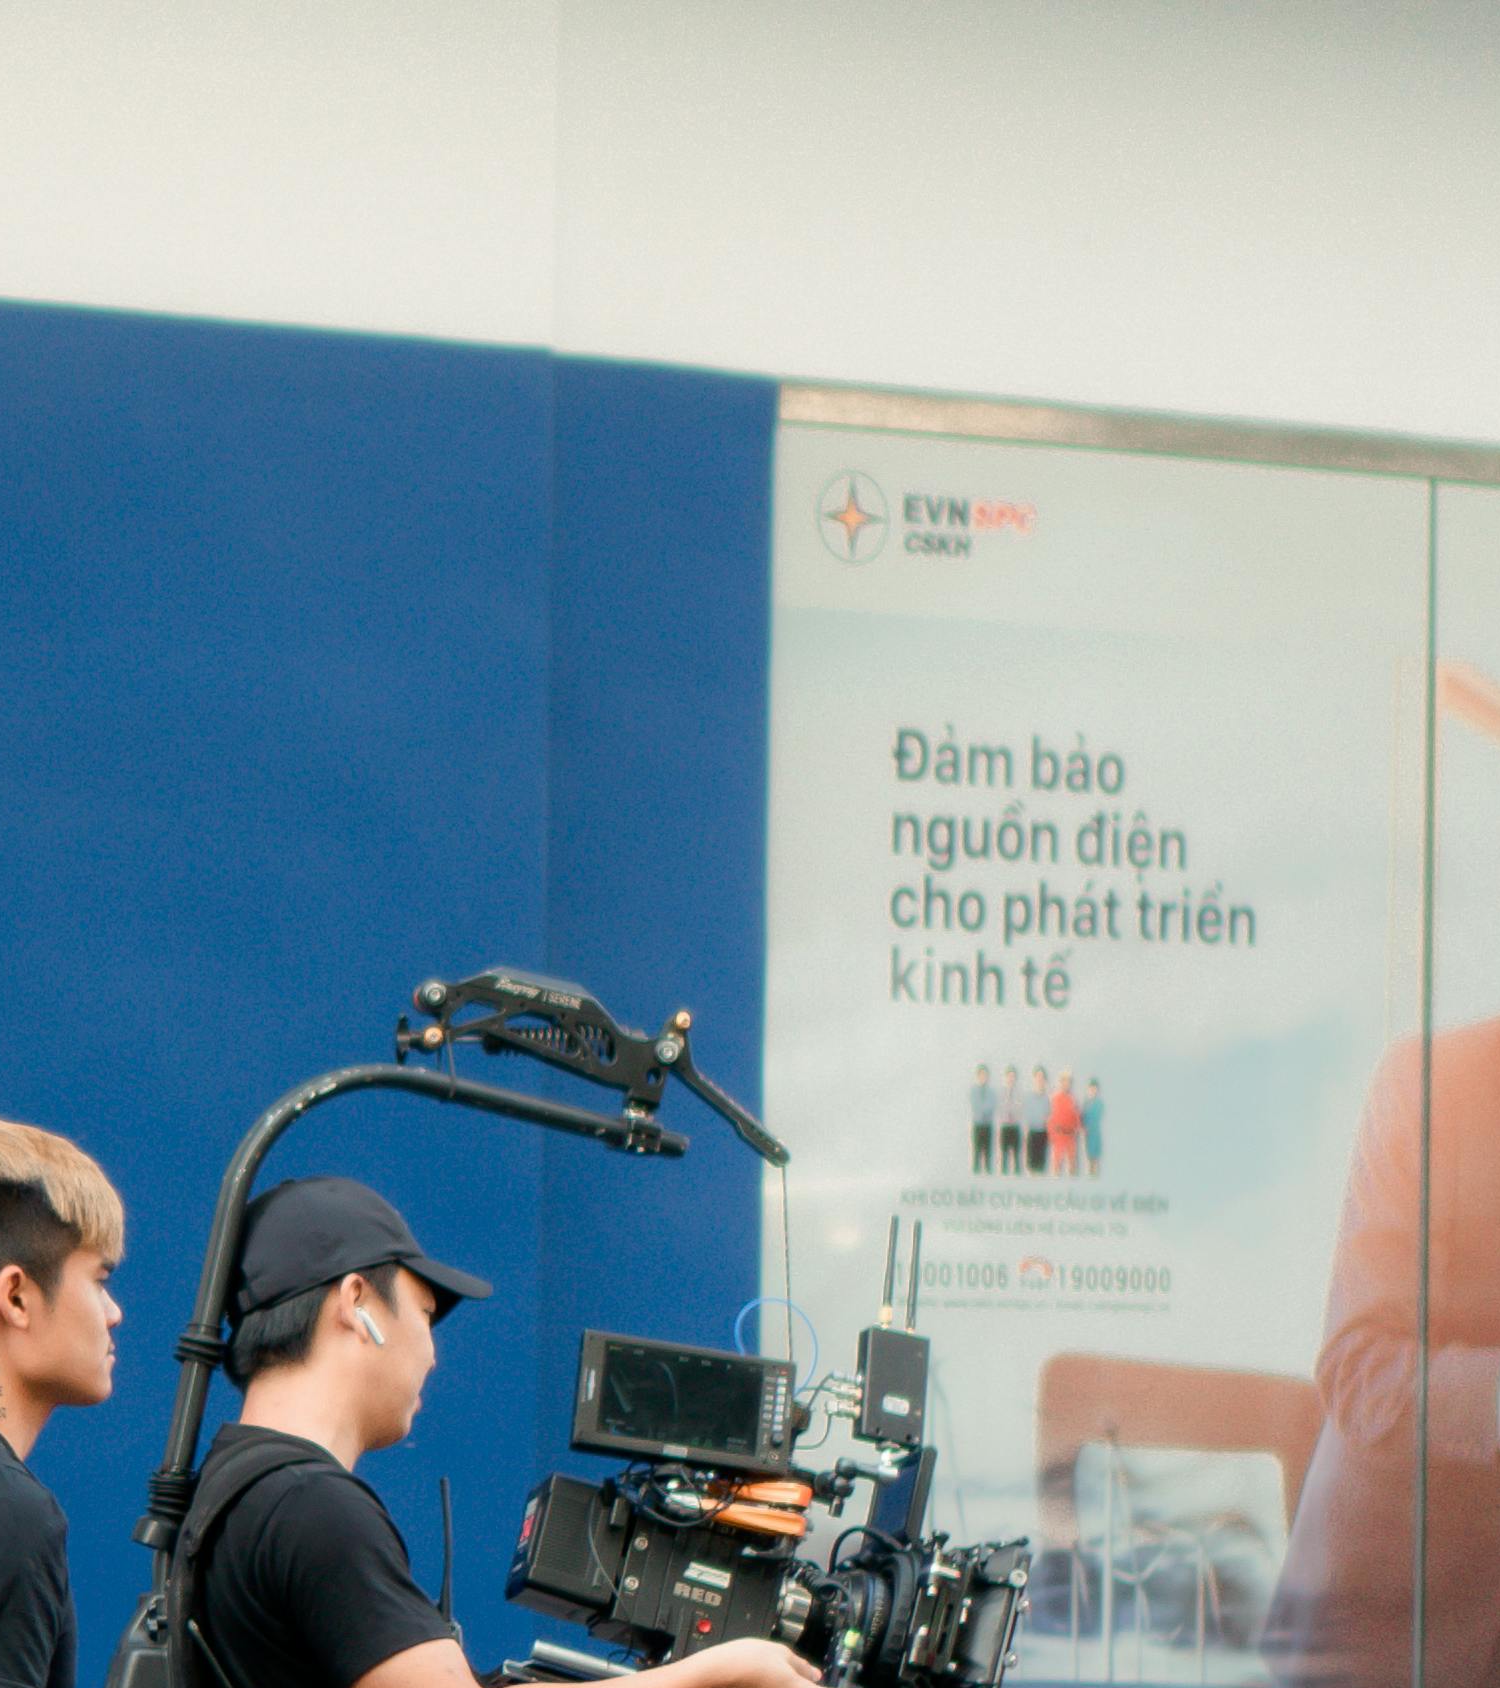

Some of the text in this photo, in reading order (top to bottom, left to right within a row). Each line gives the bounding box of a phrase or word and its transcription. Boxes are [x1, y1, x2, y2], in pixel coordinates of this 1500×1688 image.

[891, 724, 1127, 796] Đảm bảo
[890, 800, 1188, 882] nguồn điện
[889, 875, 1258, 948] cho phát triển
[889, 944, 1074, 1010] kinh tế
[896, 1261, 1010, 1290] 1001006
[1058, 1264, 1171, 1293] 19009000
